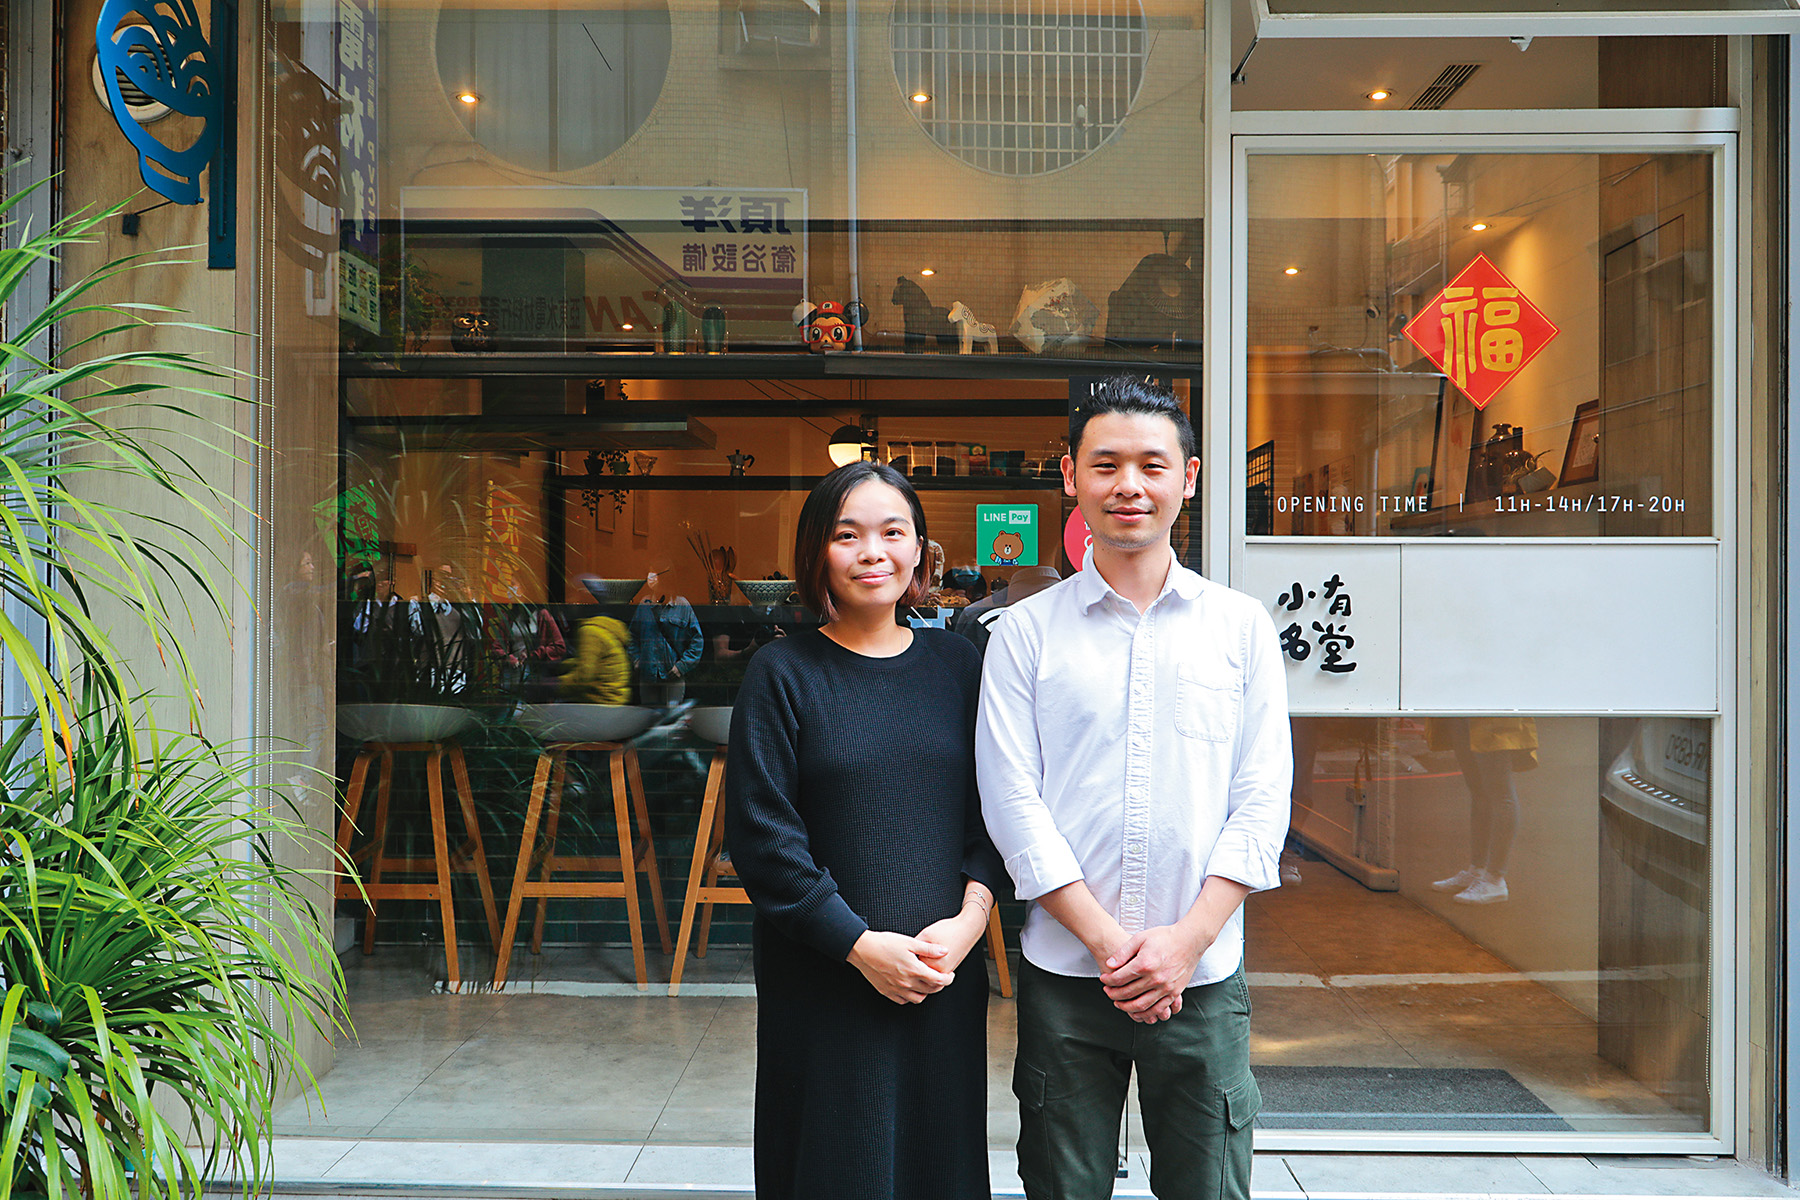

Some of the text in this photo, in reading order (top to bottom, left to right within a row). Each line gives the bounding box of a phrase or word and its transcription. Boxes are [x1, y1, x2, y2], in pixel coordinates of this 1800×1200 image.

[1440, 287, 1524, 389] 福
[1277, 496, 1365, 513] OPENING
[1379, 496, 1428, 513] TIME
[983, 512, 1029, 523] LINE Pay
